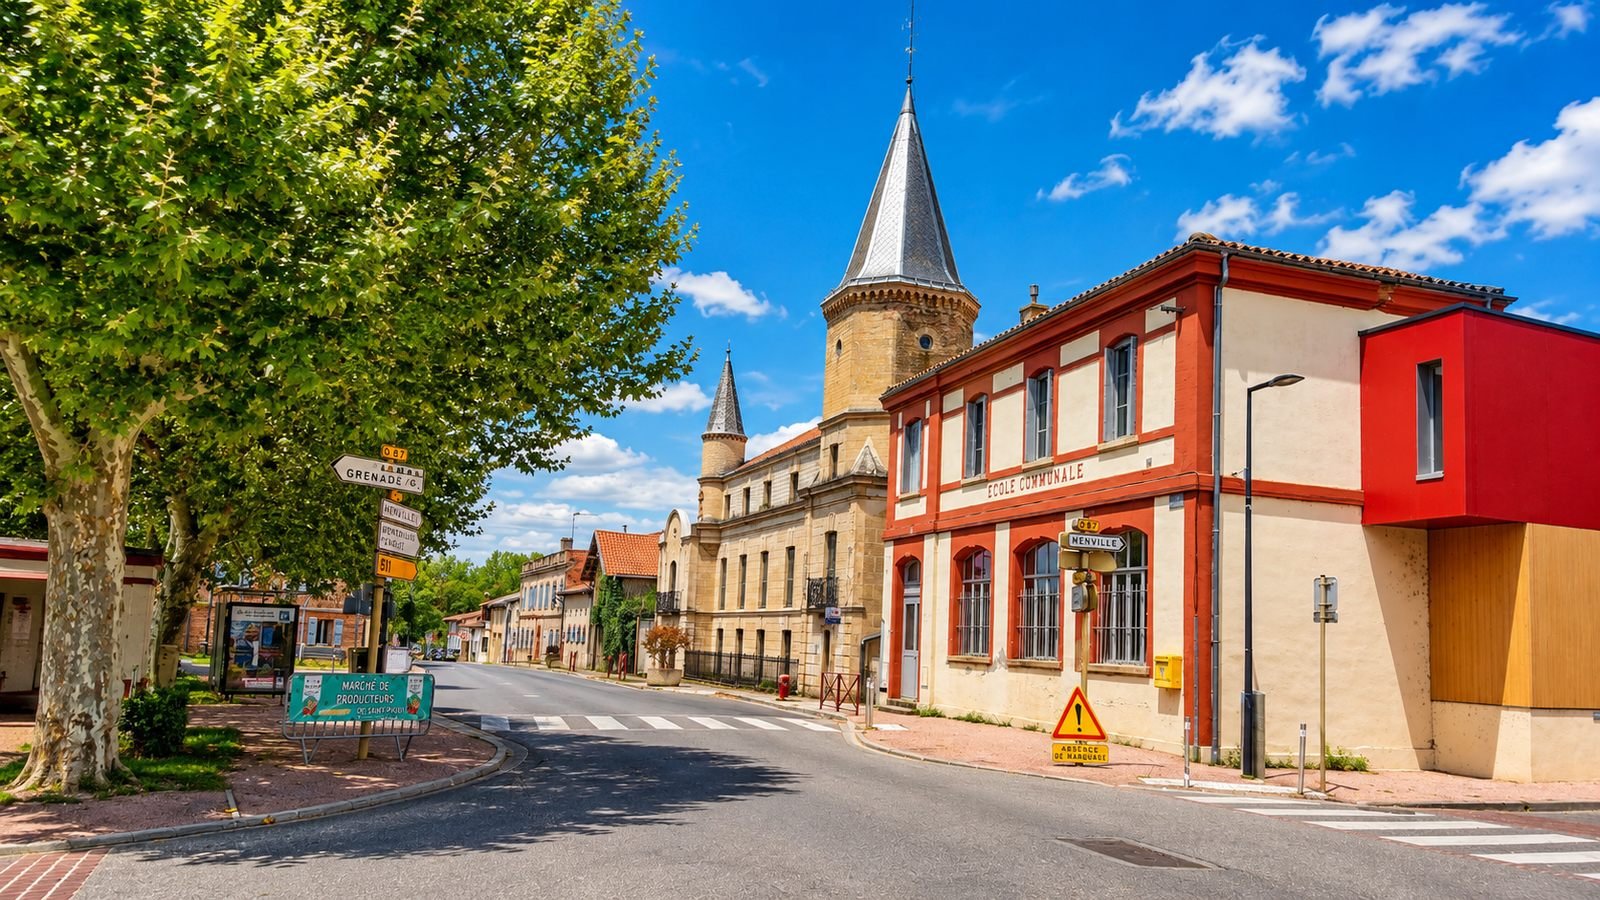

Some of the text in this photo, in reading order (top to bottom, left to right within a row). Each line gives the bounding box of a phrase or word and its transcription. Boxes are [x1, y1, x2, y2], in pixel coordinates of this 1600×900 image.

[393, 449, 405, 458] 87
[346, 468, 402, 486] GRENADE
[1020, 463, 1084, 491] COMMUNALE
[380, 681, 389, 691] DE
[336, 694, 394, 704] PRODUCTEURS
